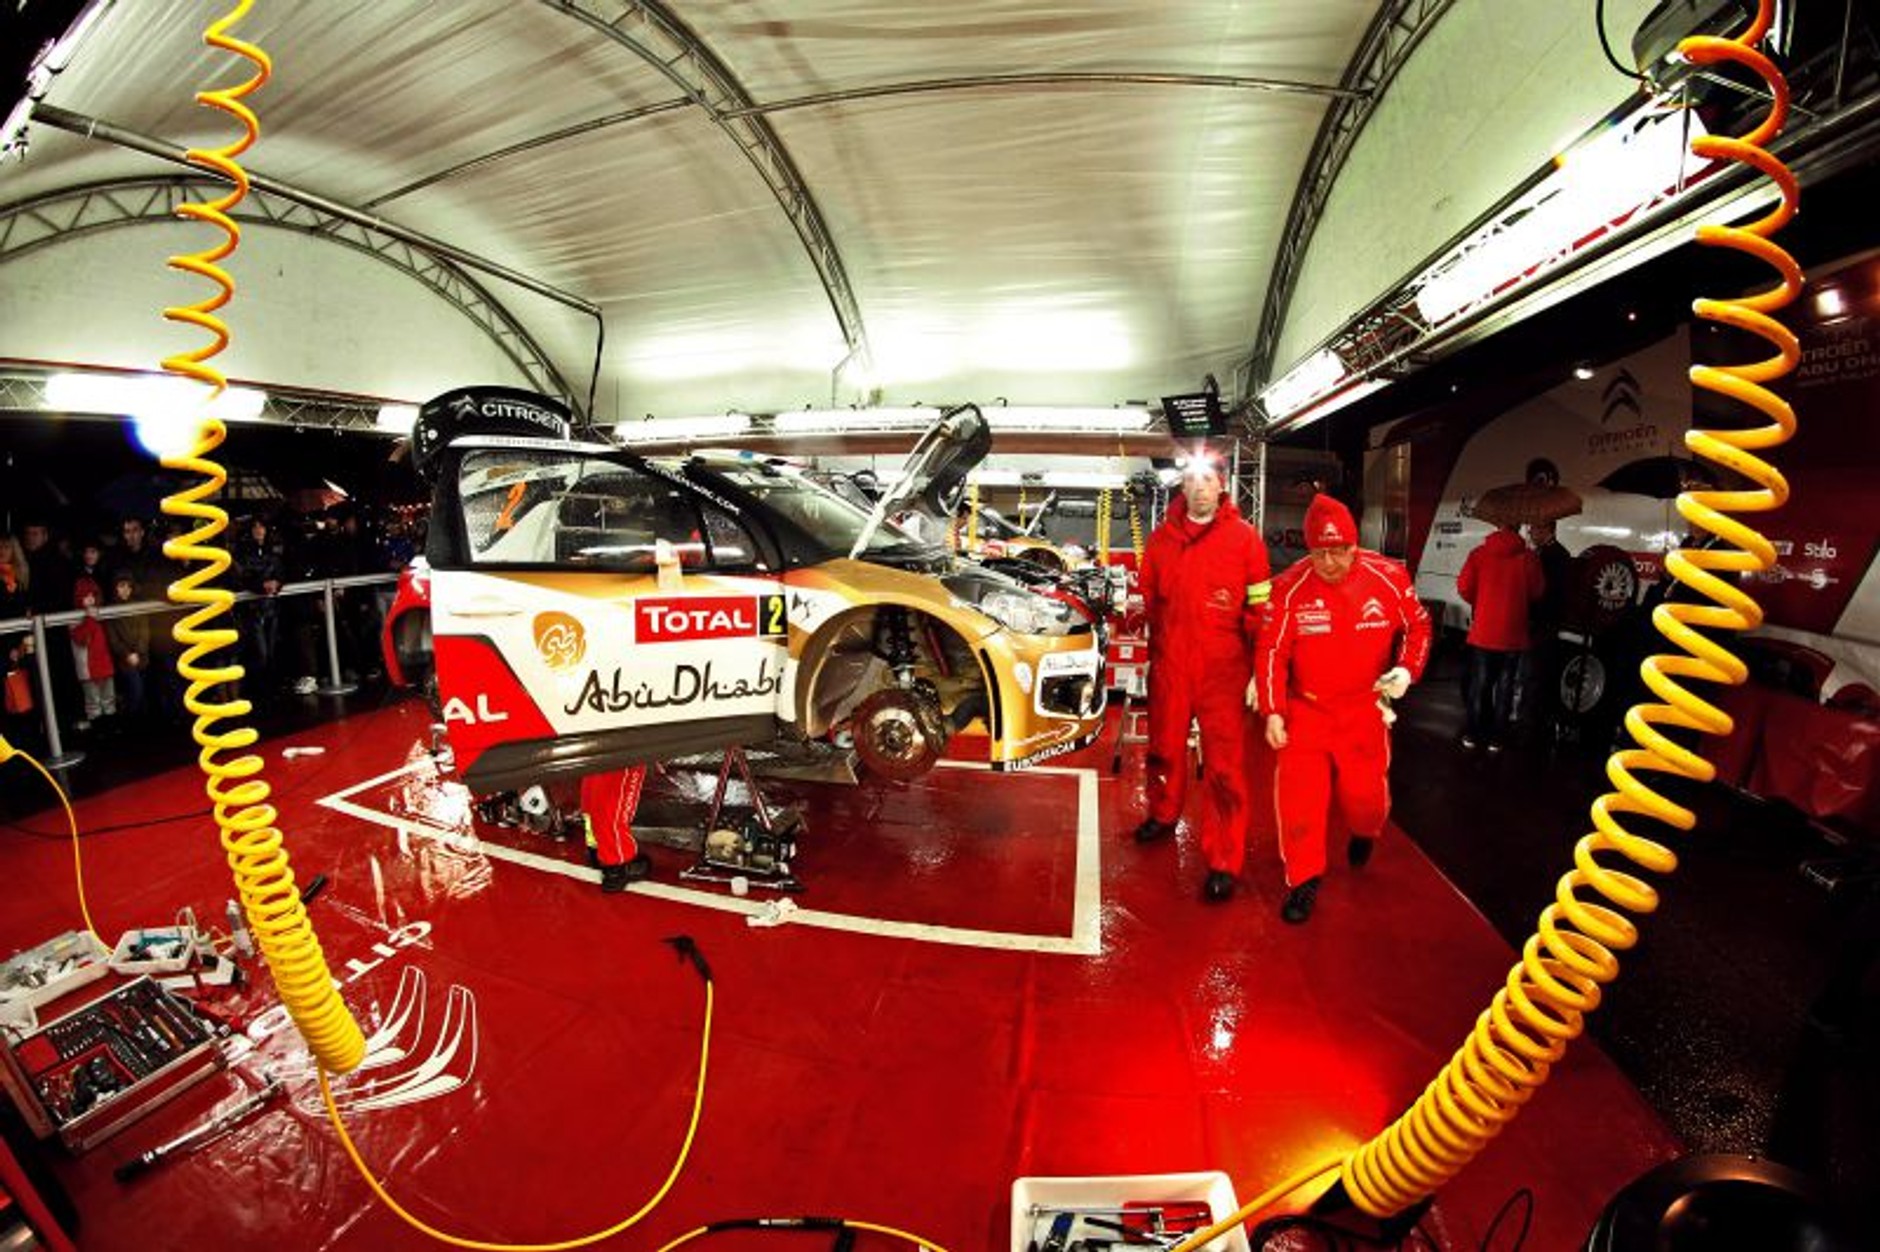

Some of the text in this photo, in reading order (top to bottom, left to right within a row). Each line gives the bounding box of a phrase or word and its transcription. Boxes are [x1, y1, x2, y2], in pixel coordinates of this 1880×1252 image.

[495, 481, 527, 529] 2
[767, 596, 783, 633] 2
[655, 657, 784, 706] Dhabi
